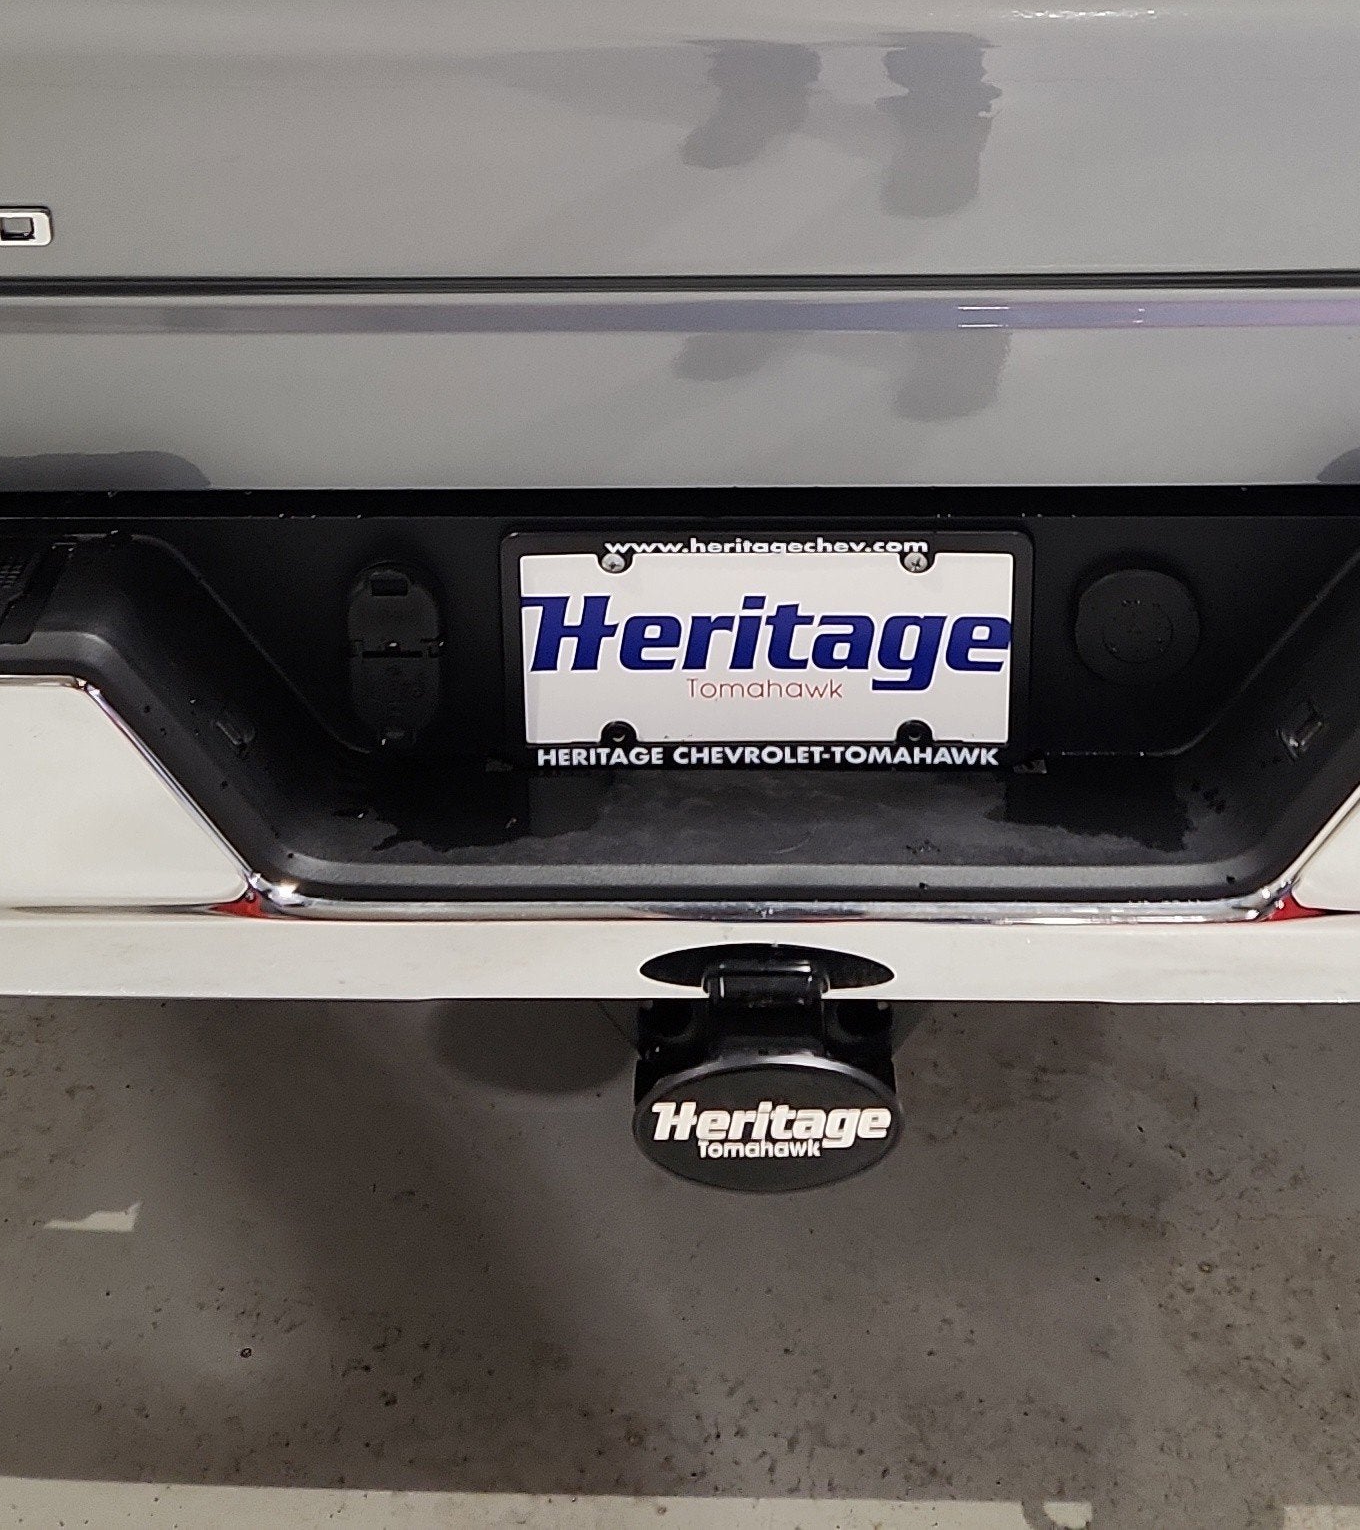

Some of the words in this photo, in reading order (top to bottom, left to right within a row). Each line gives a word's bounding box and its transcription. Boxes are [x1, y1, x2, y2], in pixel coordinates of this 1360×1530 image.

[604, 538, 929, 556] www.heritagechev.com
[520, 593, 1012, 692] Heritage
[686, 677, 843, 700] Tomahawk
[536, 746, 664, 766] HERITAGE
[672, 745, 1000, 767] CHEVROLET-TOMAHAWK
[650, 1100, 892, 1149] Heritage
[698, 1140, 821, 1159] Tomahawk
